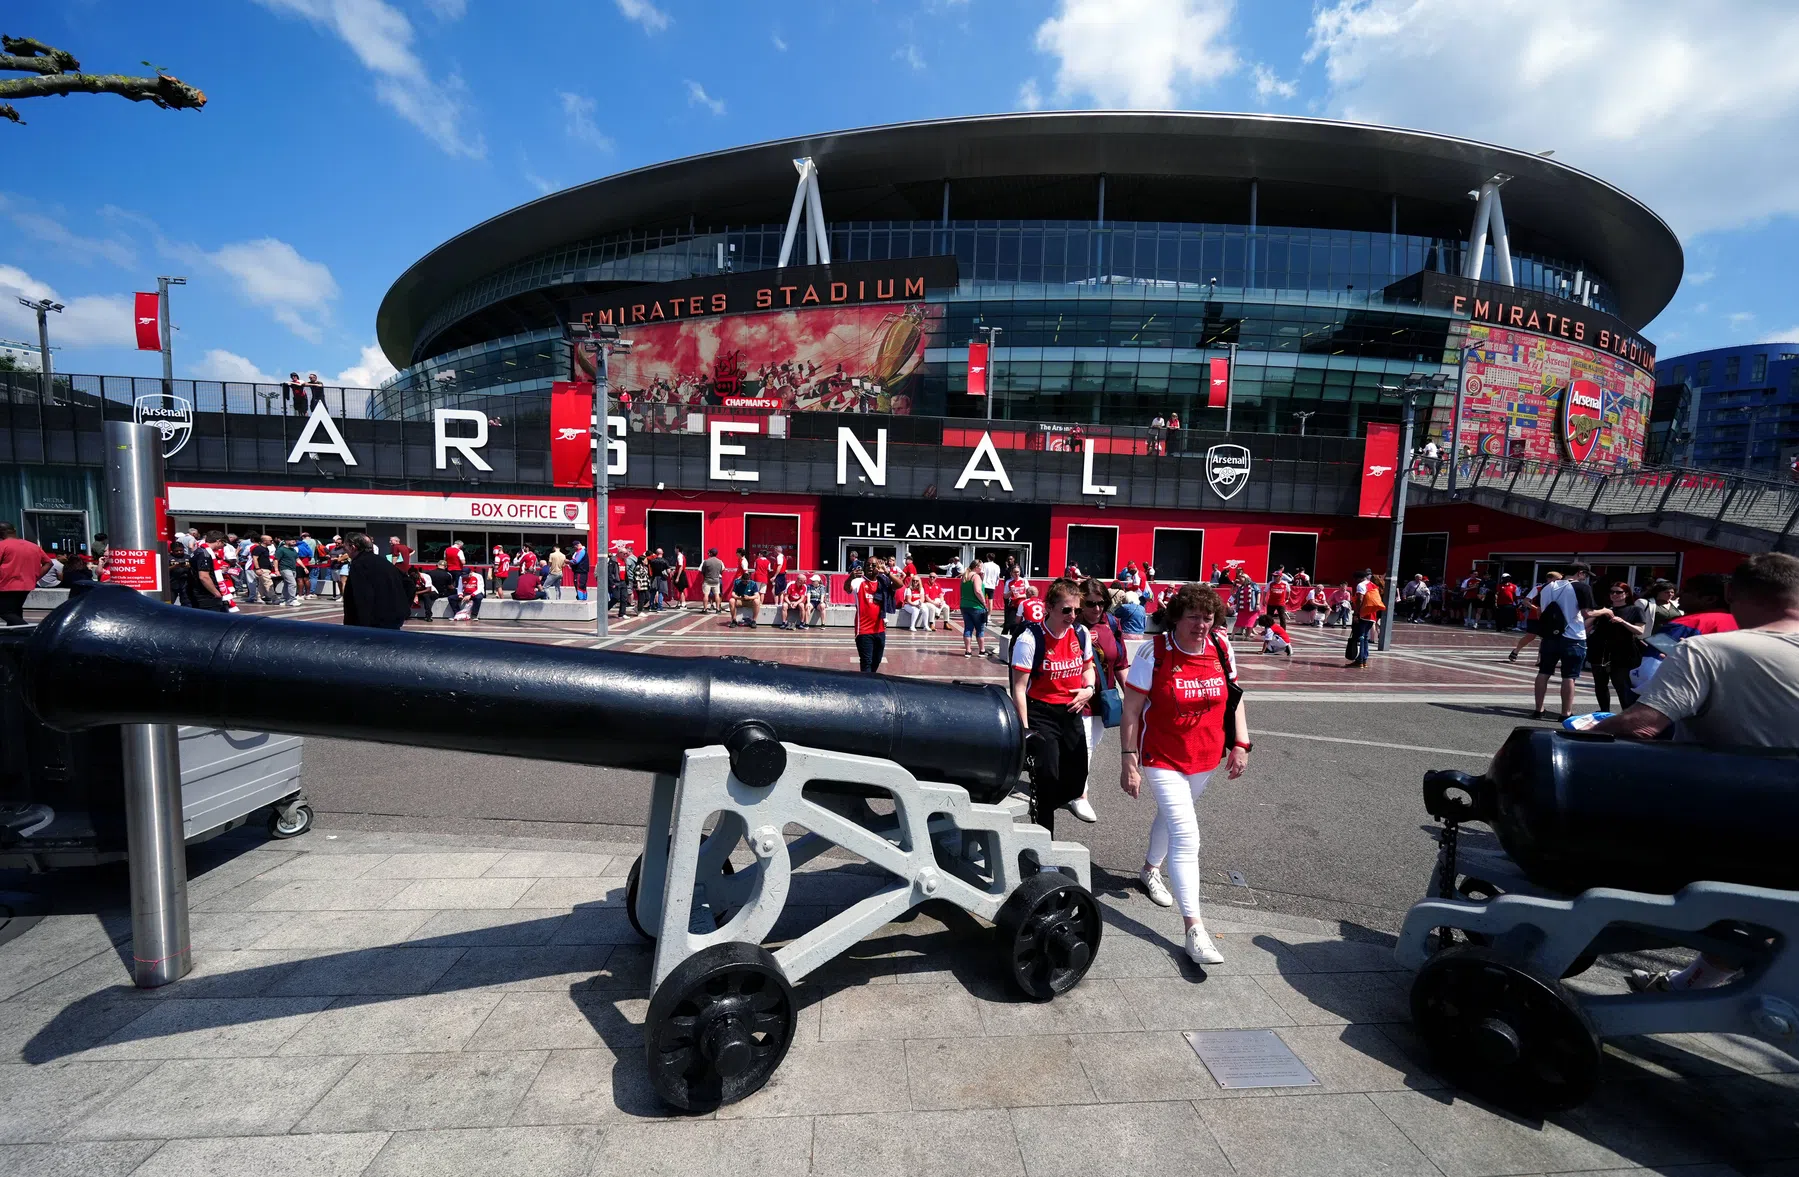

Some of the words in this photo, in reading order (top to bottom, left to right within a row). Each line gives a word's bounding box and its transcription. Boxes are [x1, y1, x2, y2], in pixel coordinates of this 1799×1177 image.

[582, 293, 726, 329] EMIRATES
[756, 277, 925, 308] STADIUM
[1453, 296, 1585, 340] EMIRATES
[1600, 330, 1655, 372] STADIUM
[725, 398, 770, 407] CHAPMAN'S
[1572, 391, 1601, 409] Arsenal
[142, 406, 186, 418] Arsenal
[1040, 423, 1051, 431] The
[1212, 455, 1245, 465] Arsenal
[471, 503, 503, 517] BOX
[507, 504, 557, 519] OFFICE
[851, 522, 896, 537] THE
[905, 524, 1021, 541] ARMOURY
[1032, 605, 1044, 620] 8
[1042, 656, 1083, 671] Emirate
[1050, 671, 1061, 680] FLY
[1184, 689, 1196, 699] FLY
[1198, 688, 1221, 698] BETTER
